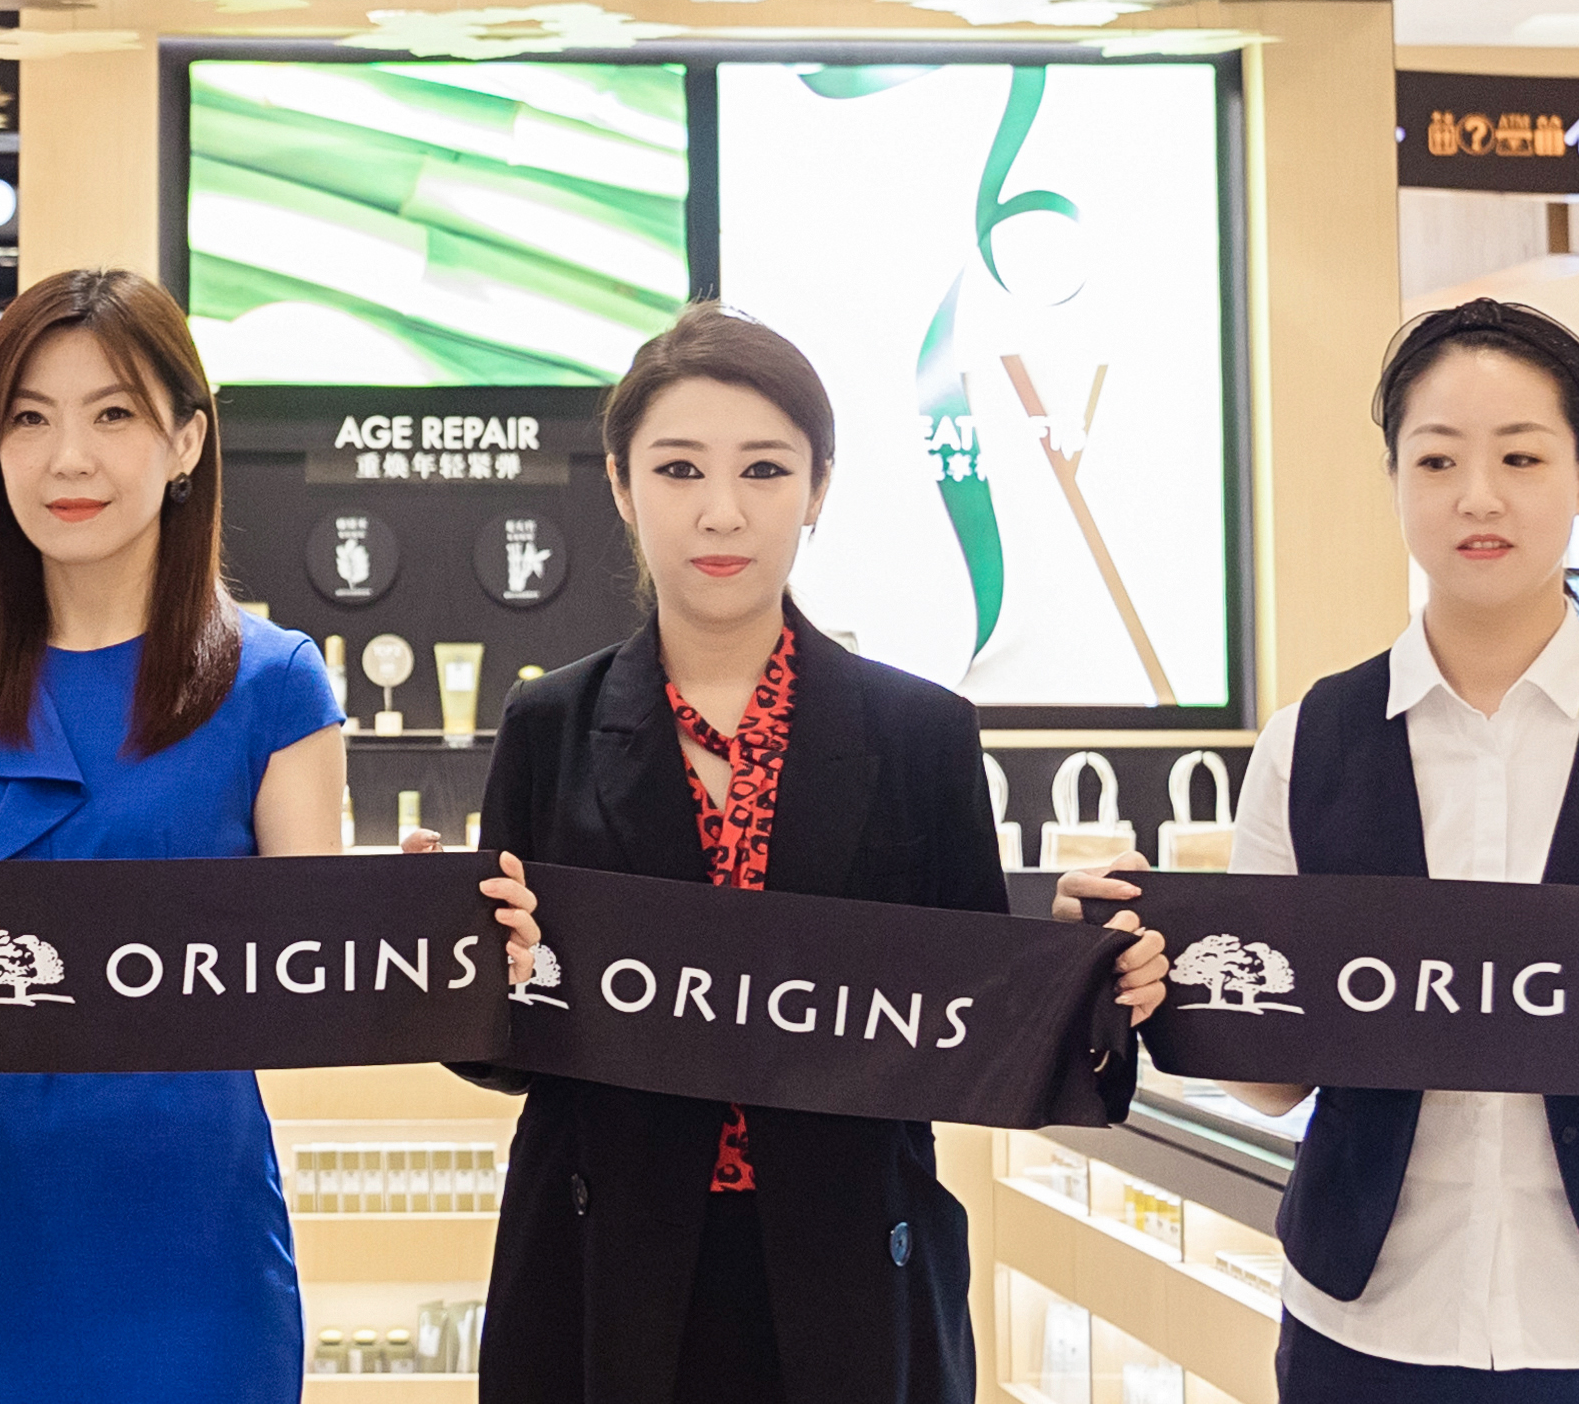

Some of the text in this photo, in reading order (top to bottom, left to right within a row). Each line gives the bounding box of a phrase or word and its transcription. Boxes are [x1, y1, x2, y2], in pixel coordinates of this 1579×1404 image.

[334, 415, 541, 451] AGE REPAIR
[105, 935, 480, 998] ORIGINS
[599, 957, 974, 1049] ORIGINS
